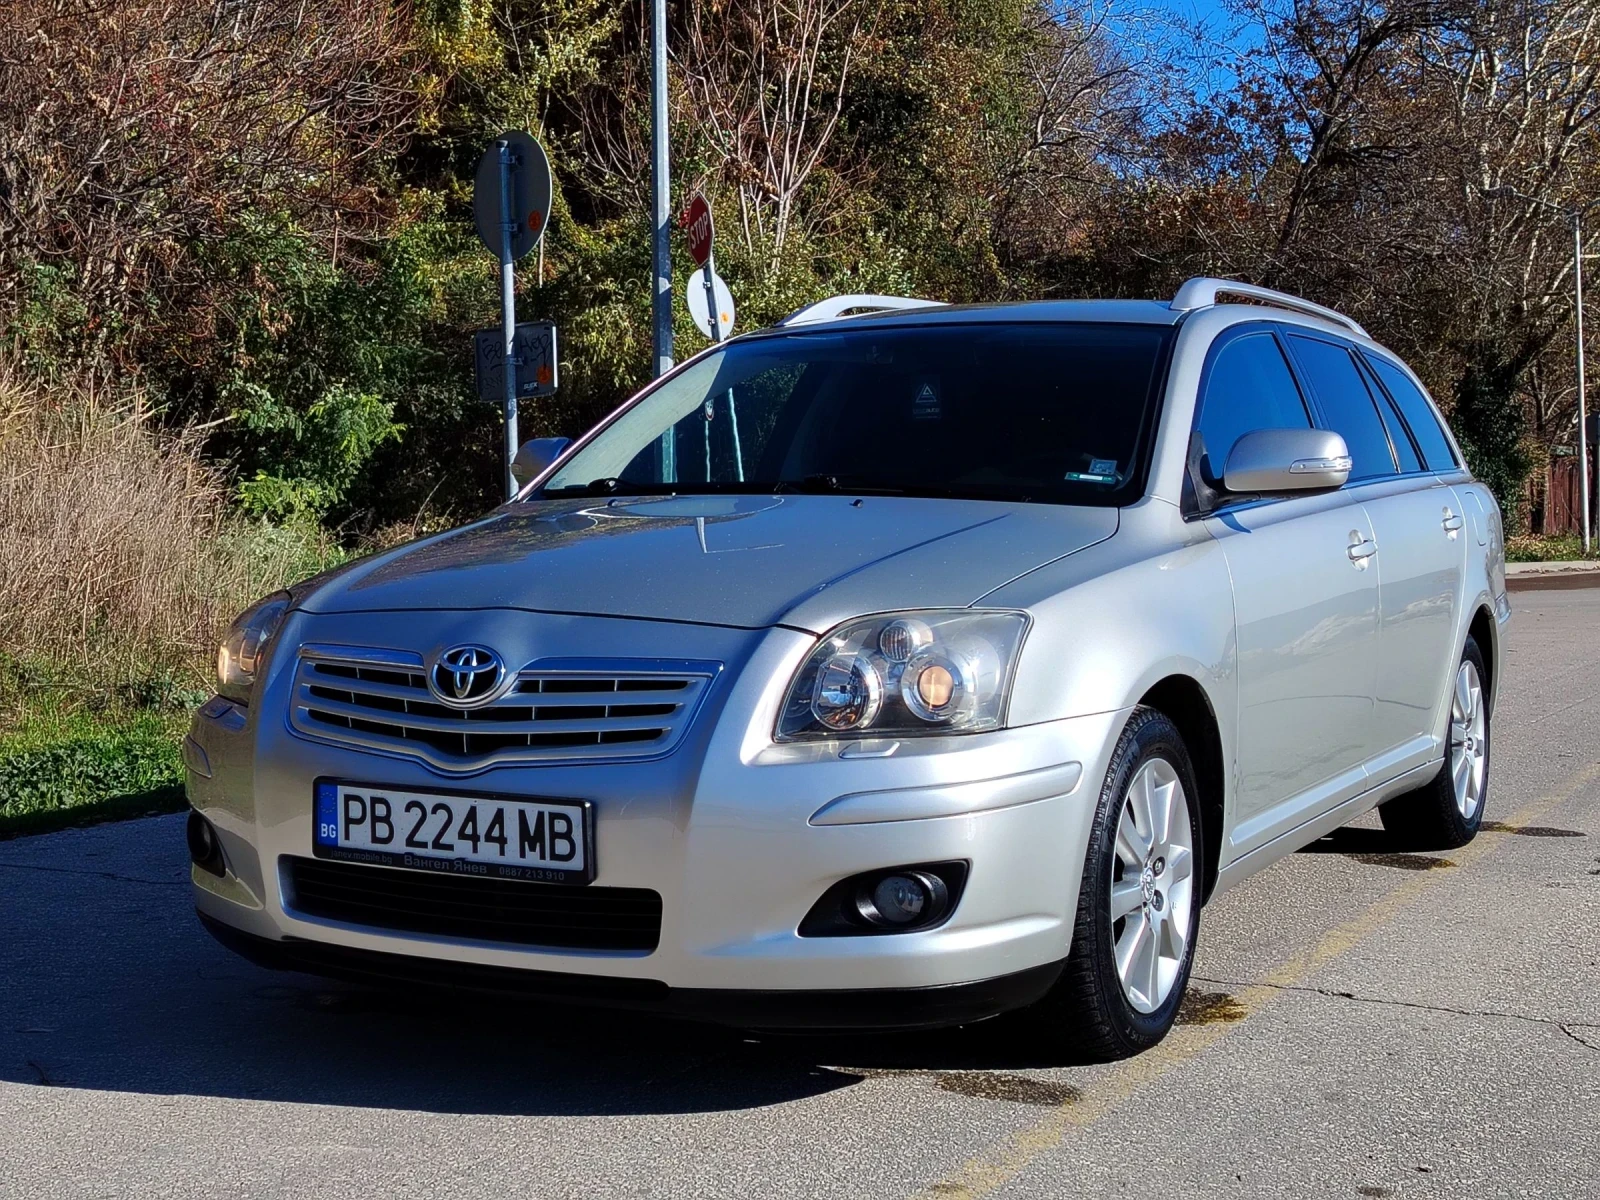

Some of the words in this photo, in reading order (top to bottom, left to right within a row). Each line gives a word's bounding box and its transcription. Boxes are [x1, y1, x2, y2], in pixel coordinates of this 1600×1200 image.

[690, 211, 709, 250] STOP
[321, 823, 337, 838] BG
[343, 793, 395, 845] PB
[404, 800, 508, 857] 2244
[518, 808, 577, 863] MB
[403, 854, 450, 871] Вангел
[453, 859, 488, 874] Янев
[499, 866, 522, 877] 0887
[525, 868, 544, 879] 213
[545, 870, 565, 881] 910
